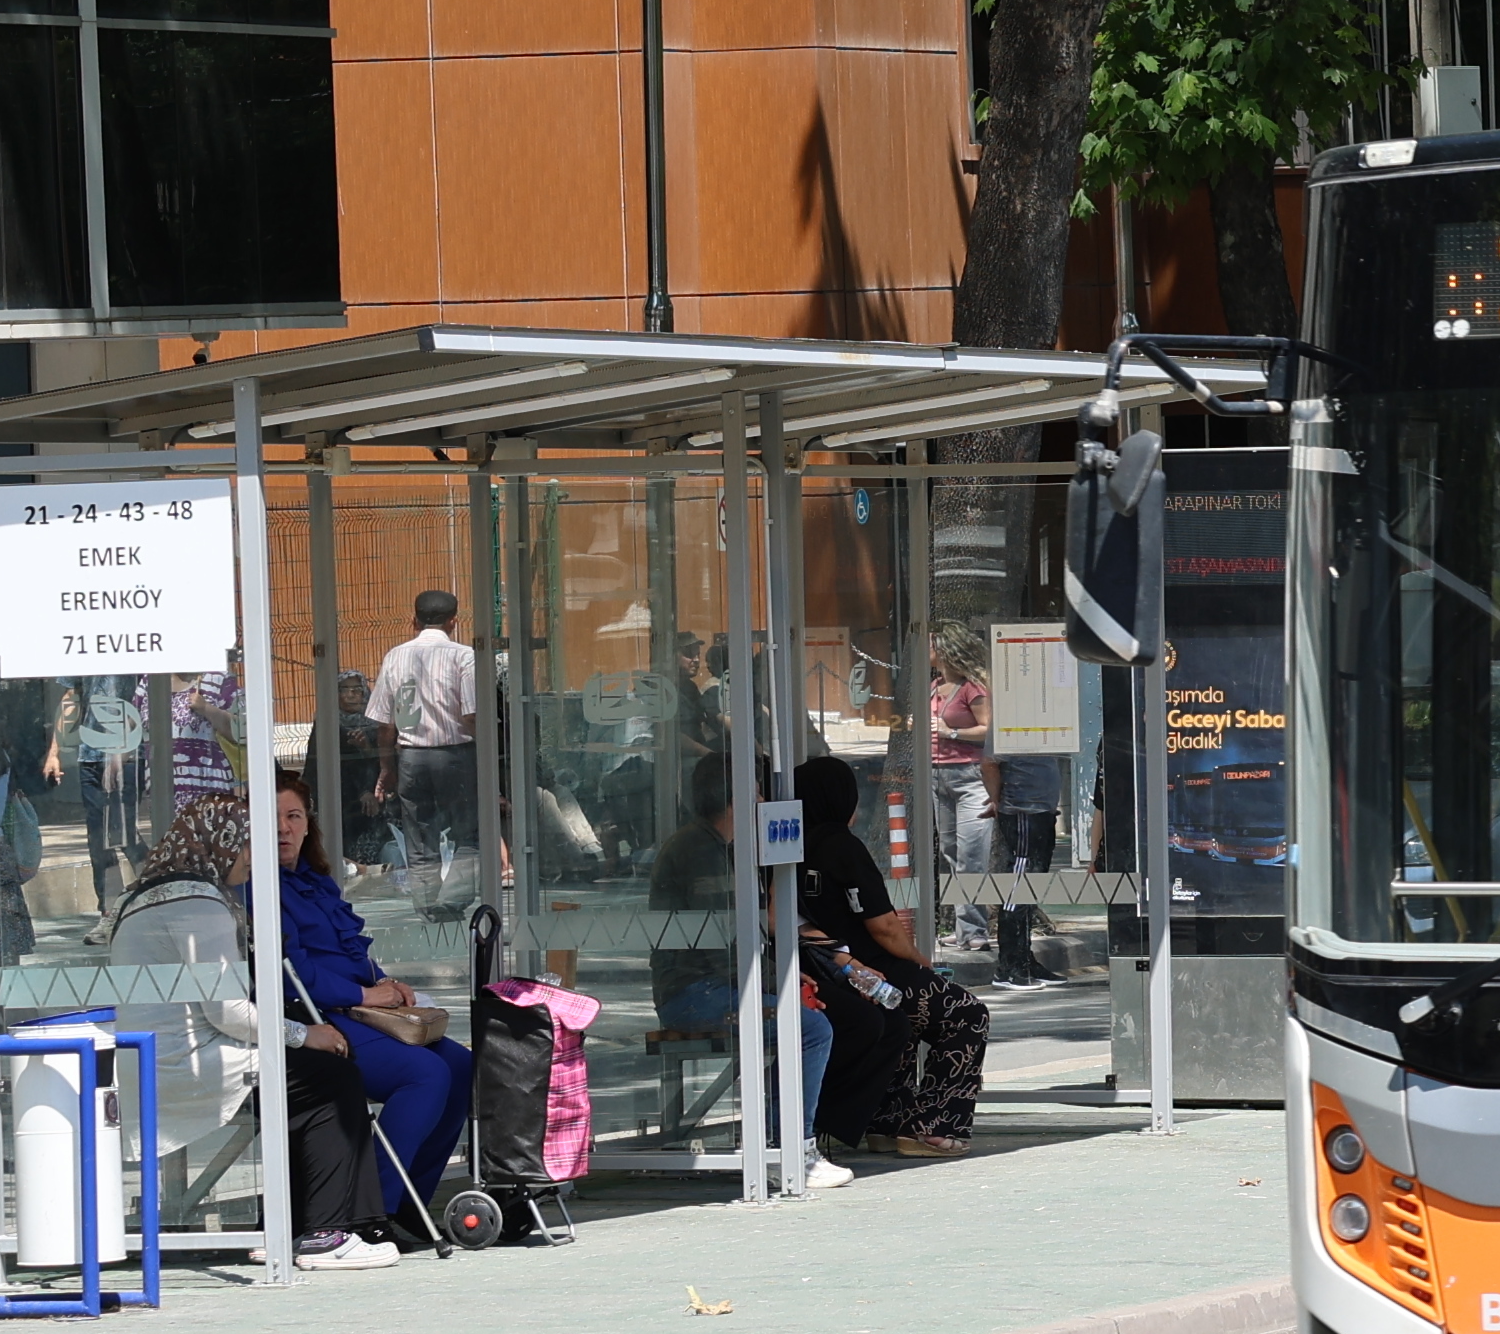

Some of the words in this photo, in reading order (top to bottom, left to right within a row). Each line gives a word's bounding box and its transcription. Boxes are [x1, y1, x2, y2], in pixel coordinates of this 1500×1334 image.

[24, 505, 50, 525] 21
[72, 503, 98, 524] 24
[119, 501, 145, 522] 43
[167, 500, 193, 520] 48
[1246, 492, 1281, 510] TOKİ
[79, 546, 142, 567] EMEK
[61, 584, 162, 611] ERENKÖY
[62, 635, 88, 655] 71
[96, 632, 163, 654] EVLER
[1167, 709, 1232, 733] Geceyi
[1234, 709, 1286, 728] Saba
[1166, 731, 1223, 754] ğladık!
